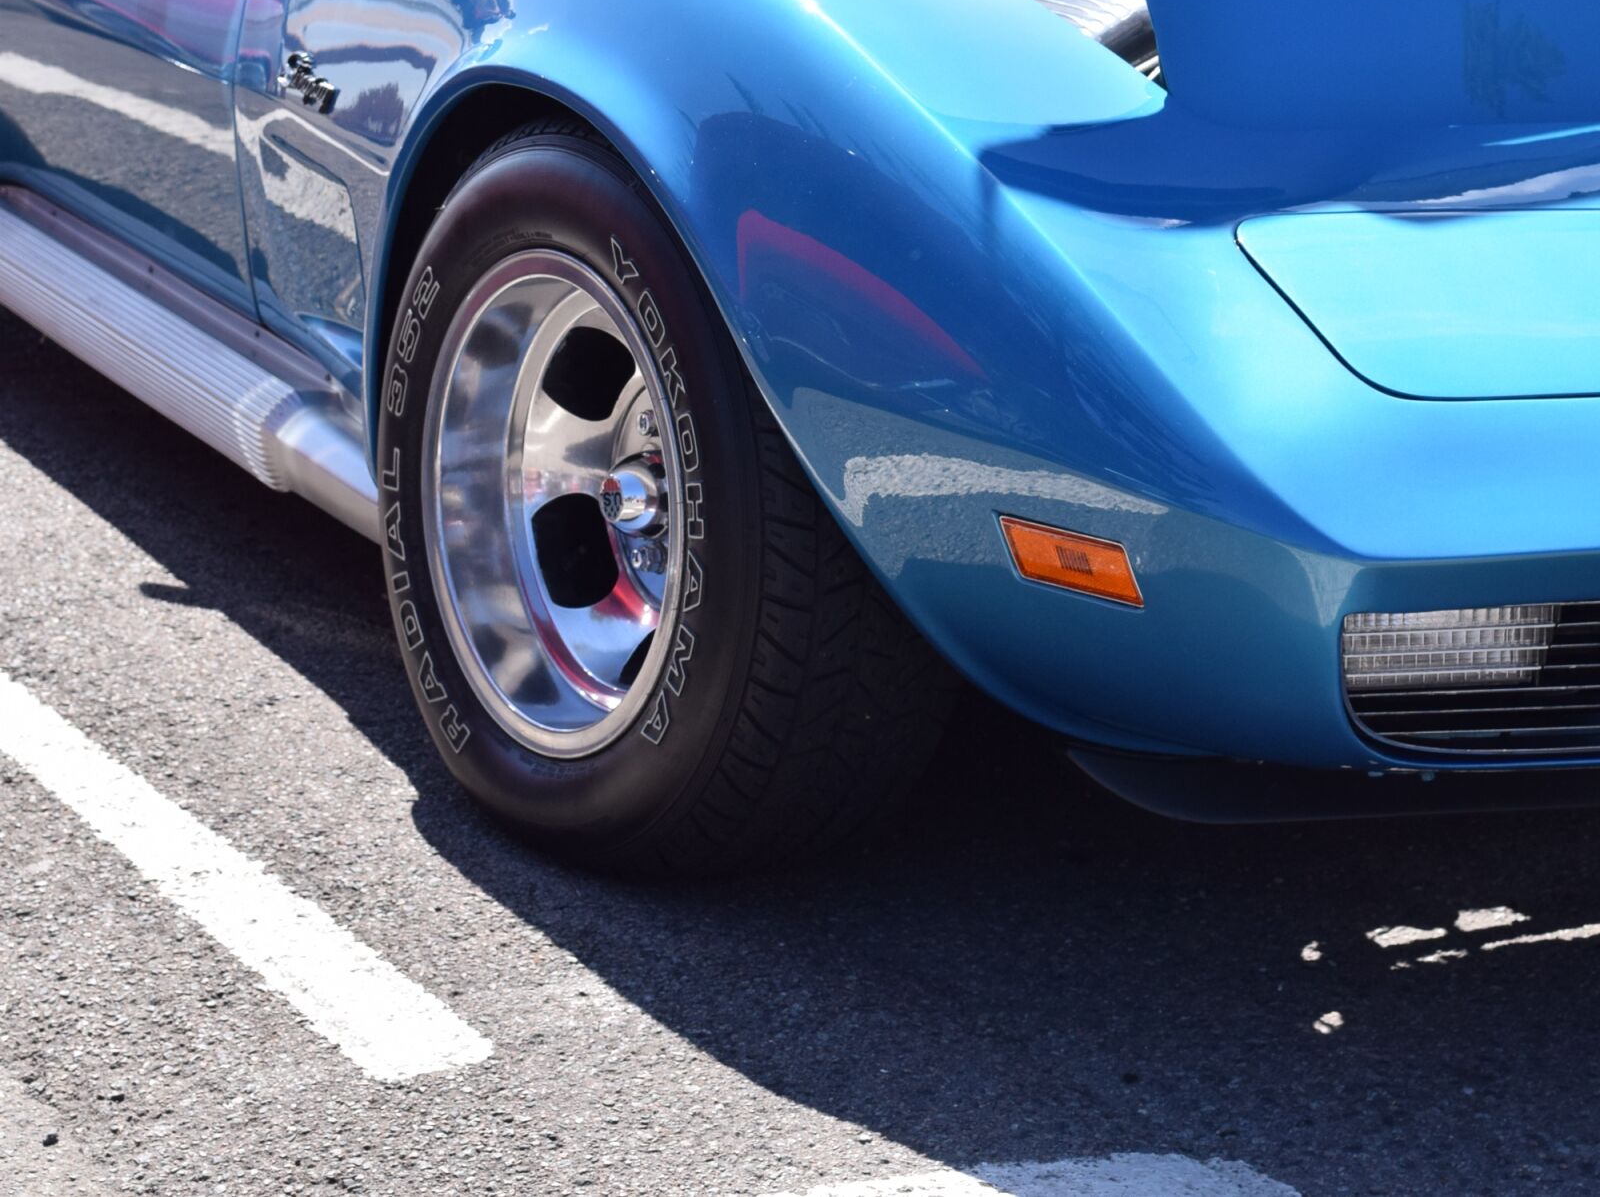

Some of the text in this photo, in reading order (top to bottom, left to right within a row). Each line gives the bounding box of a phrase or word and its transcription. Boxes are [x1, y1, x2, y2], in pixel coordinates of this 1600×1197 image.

[383, 265, 470, 754] RADIAL 352
[610, 236, 705, 745] YOKOHAMA
